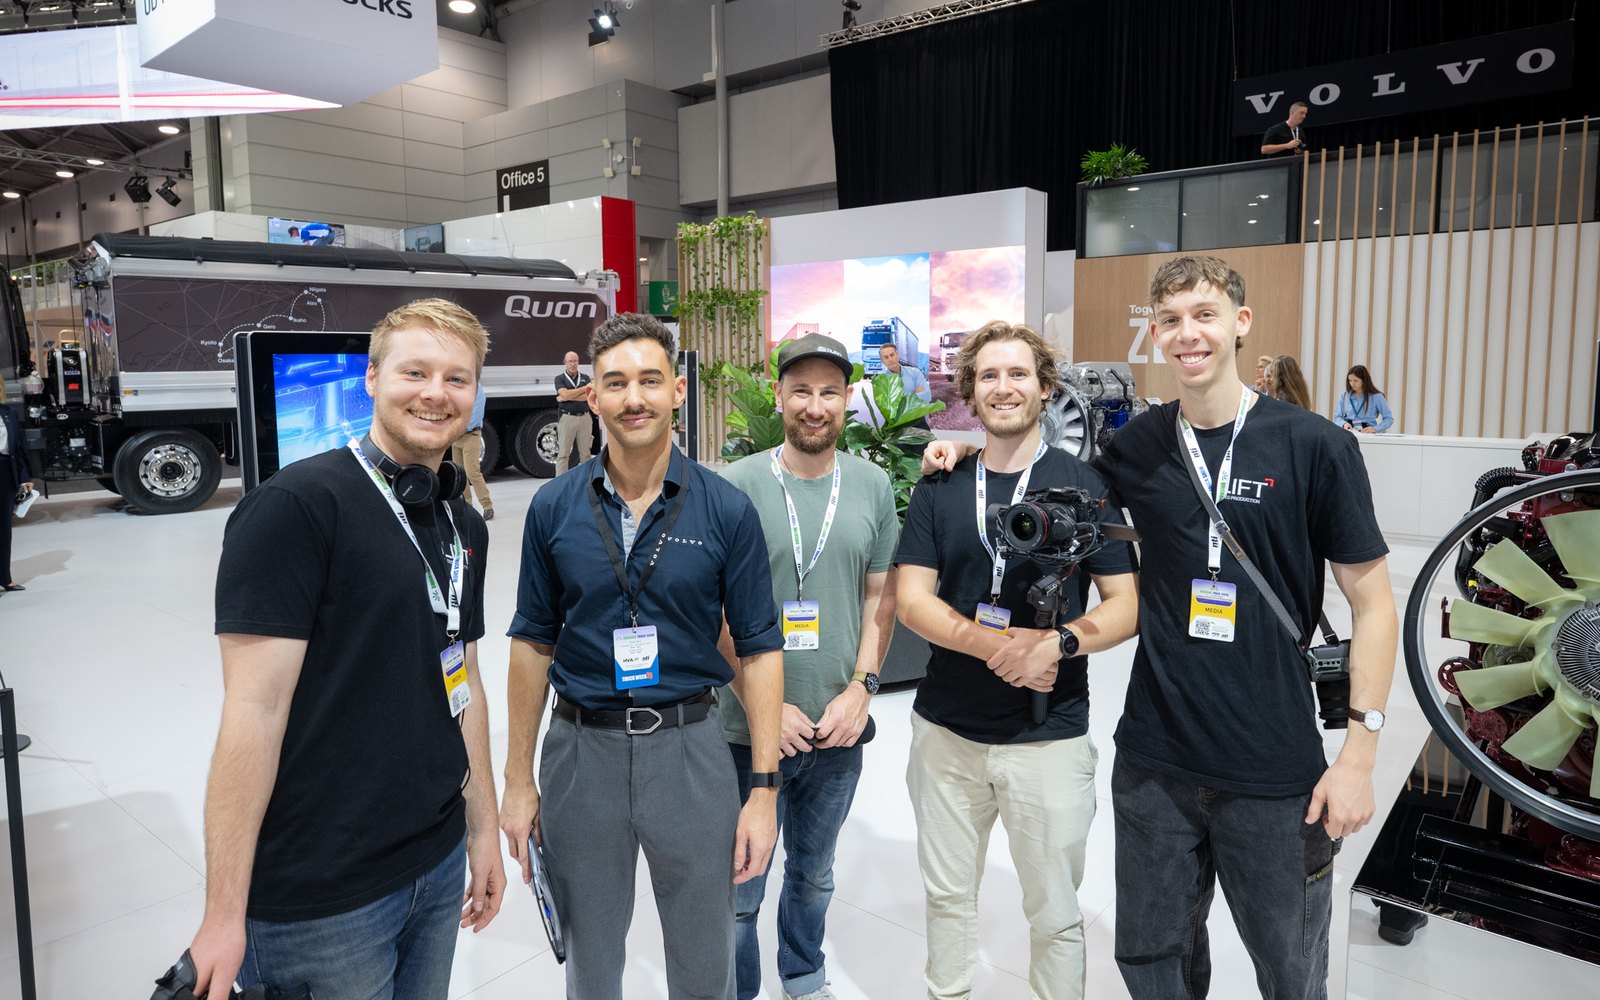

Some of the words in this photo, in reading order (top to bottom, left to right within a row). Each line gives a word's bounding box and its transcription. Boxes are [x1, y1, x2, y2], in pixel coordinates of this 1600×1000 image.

[1245, 48, 1556, 115] VOLVO
[501, 170, 535, 189] Office
[537, 166, 545, 183] 5
[504, 295, 597, 319] Quon
[1129, 305, 1154, 316] Toge
[200, 339, 217, 347] Kyoto
[1227, 477, 1269, 498] IFT
[1230, 495, 1261, 504] PRODUCTION
[649, 533, 666, 566] VOLVO
[667, 536, 703, 545] VOLVO
